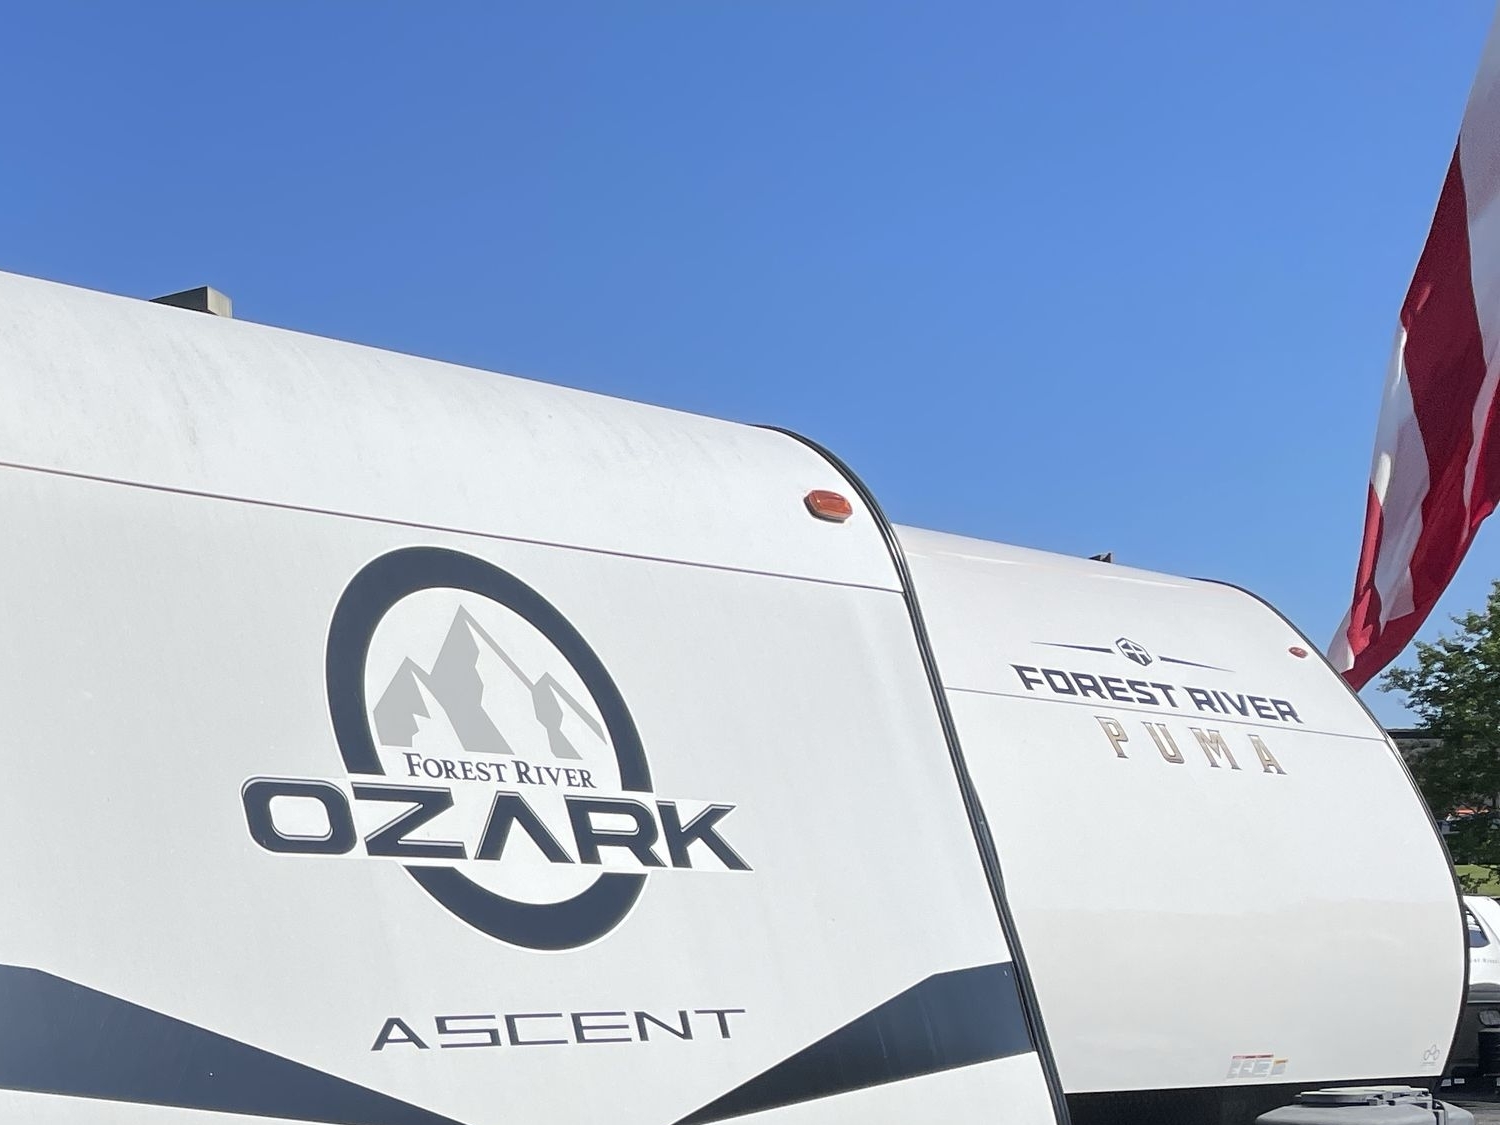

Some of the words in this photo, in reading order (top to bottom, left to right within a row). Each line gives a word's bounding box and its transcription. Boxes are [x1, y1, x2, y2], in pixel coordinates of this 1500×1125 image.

[1009, 664, 1179, 708] FOREST
[1183, 687, 1304, 724] RIVER
[1094, 715, 1288, 776] PUMA
[240, 776, 754, 872] OZARK
[370, 1008, 746, 1051] ASCENT
